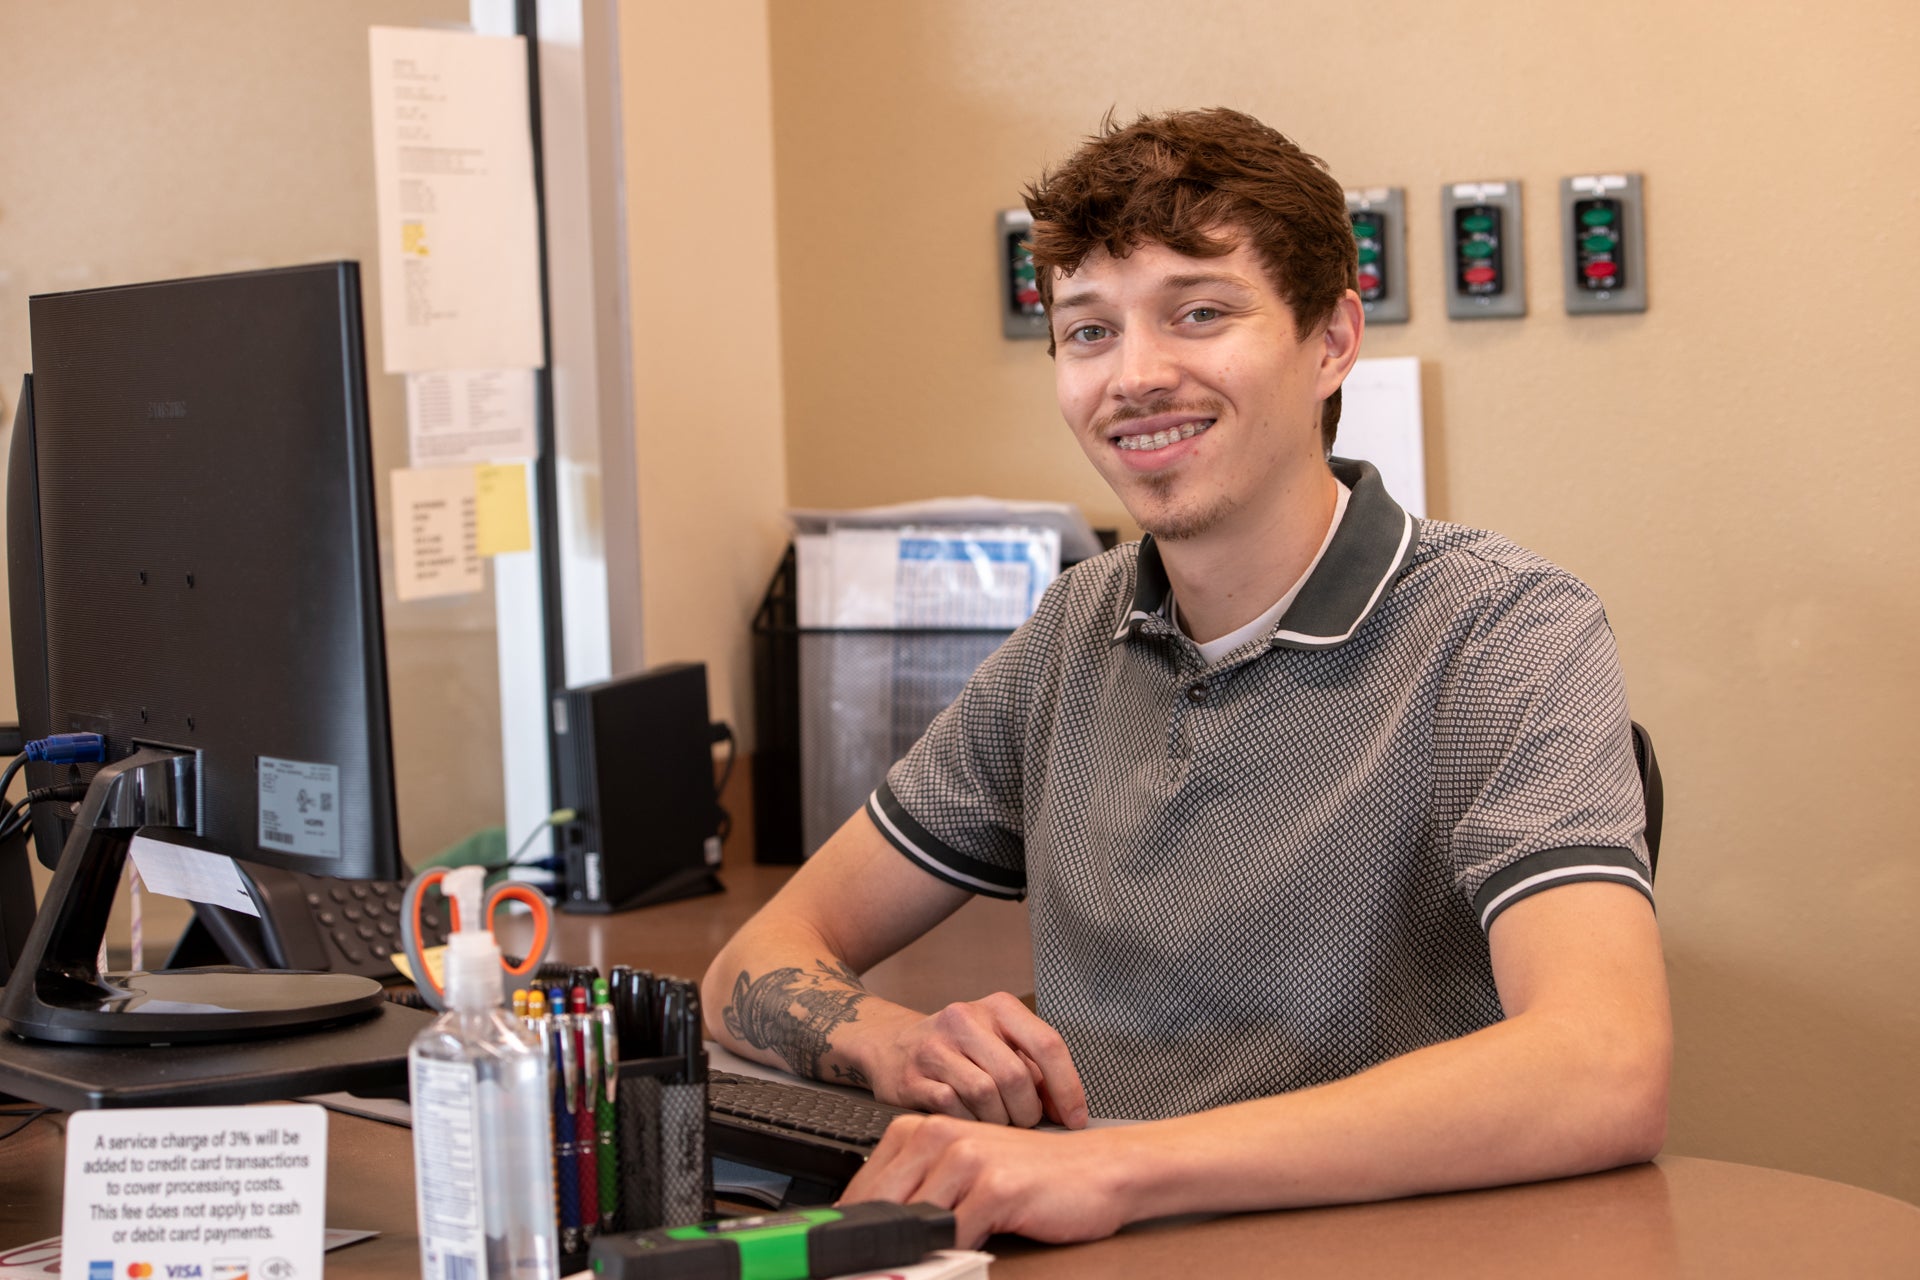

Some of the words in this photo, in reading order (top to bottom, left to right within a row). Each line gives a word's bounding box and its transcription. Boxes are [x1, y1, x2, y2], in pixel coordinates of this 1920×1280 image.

[94, 1134, 105, 1150] A
[108, 1132, 158, 1150] service
[161, 1131, 208, 1151] charge
[211, 1130, 226, 1147] of
[228, 1130, 251, 1147] 3%
[254, 1128, 278, 1145] will
[282, 1128, 300, 1145] be
[83, 1157, 127, 1174] added
[130, 1158, 144, 1172] to
[147, 1155, 187, 1172] credit
[190, 1154, 221, 1170] card
[225, 1152, 309, 1169] transactions
[106, 1181, 120, 1196] to
[123, 1182, 162, 1196] cover
[165, 1176, 241, 1198] processing
[244, 1176, 284, 1192] costs.
[90, 1203, 118, 1220] This
[121, 1203, 142, 1219] fee
[145, 1202, 179, 1218] does
[182, 1203, 206, 1217] not
[209, 1201, 247, 1221] apply
[250, 1202, 264, 1216] to
[267, 1199, 301, 1216] cash
[112, 1230, 127, 1243] or
[130, 1226, 166, 1242] debit
[168, 1225, 200, 1242] card
[203, 1226, 274, 1244] payments.
[165, 1264, 202, 1278] VISA
